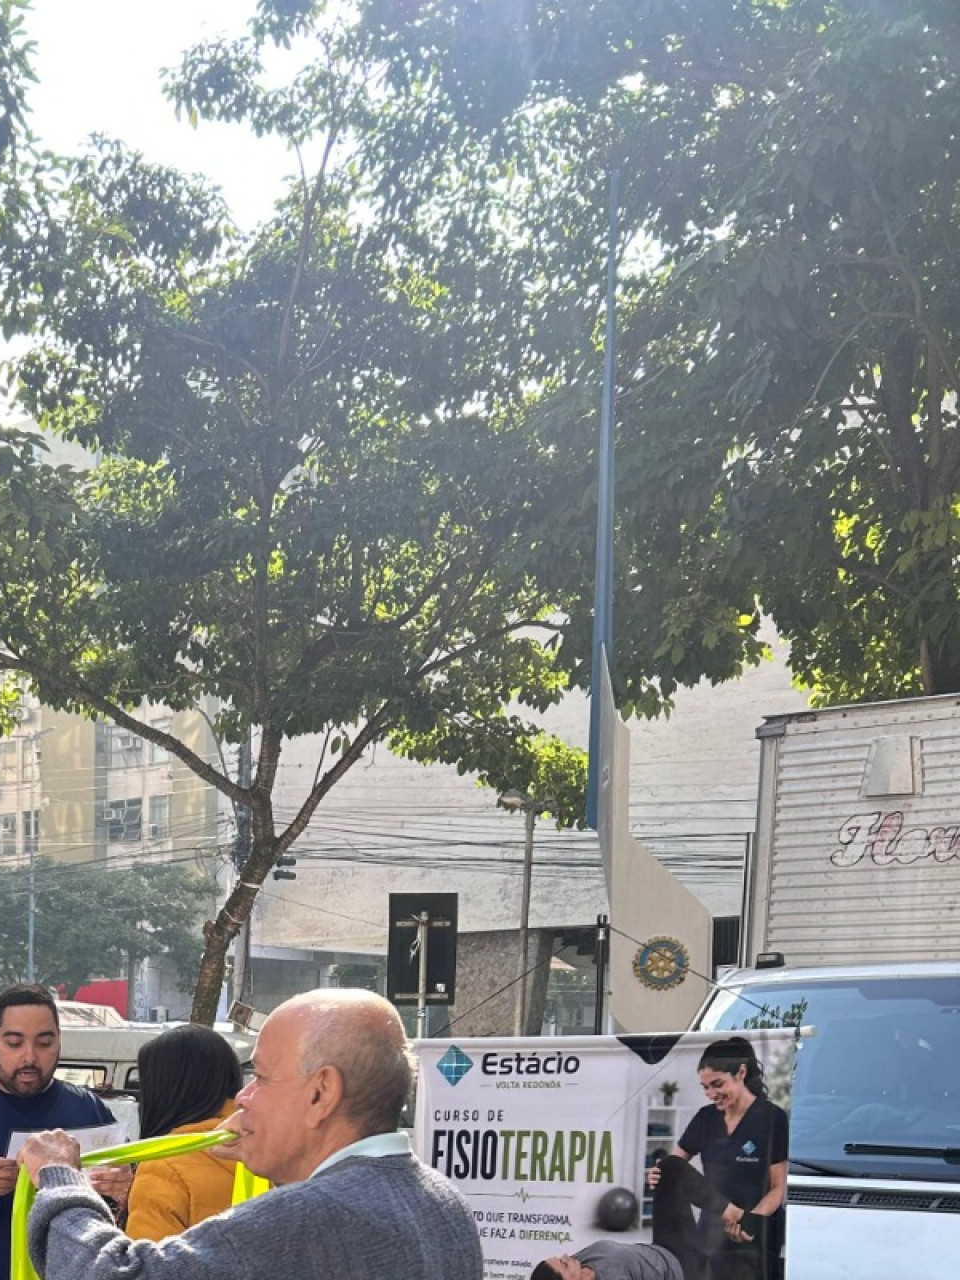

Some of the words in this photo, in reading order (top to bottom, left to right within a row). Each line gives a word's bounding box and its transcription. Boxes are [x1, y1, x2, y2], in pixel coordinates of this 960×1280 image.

[481, 1051, 580, 1076] Estácio
[496, 1081, 520, 1089] VOLTA
[523, 1081, 562, 1089] REDONDA
[434, 1110, 480, 1122] CURSO
[487, 1110, 504, 1122] DE
[432, 1129, 614, 1183] FISIOTERAPIA
[486, 1211, 505, 1222] QUE
[507, 1212, 572, 1226] TRANSFORMA,
[490, 1228, 508, 1239] FAZ
[509, 1229, 516, 1239] A
[518, 1229, 573, 1244] DIFERENÇA.
